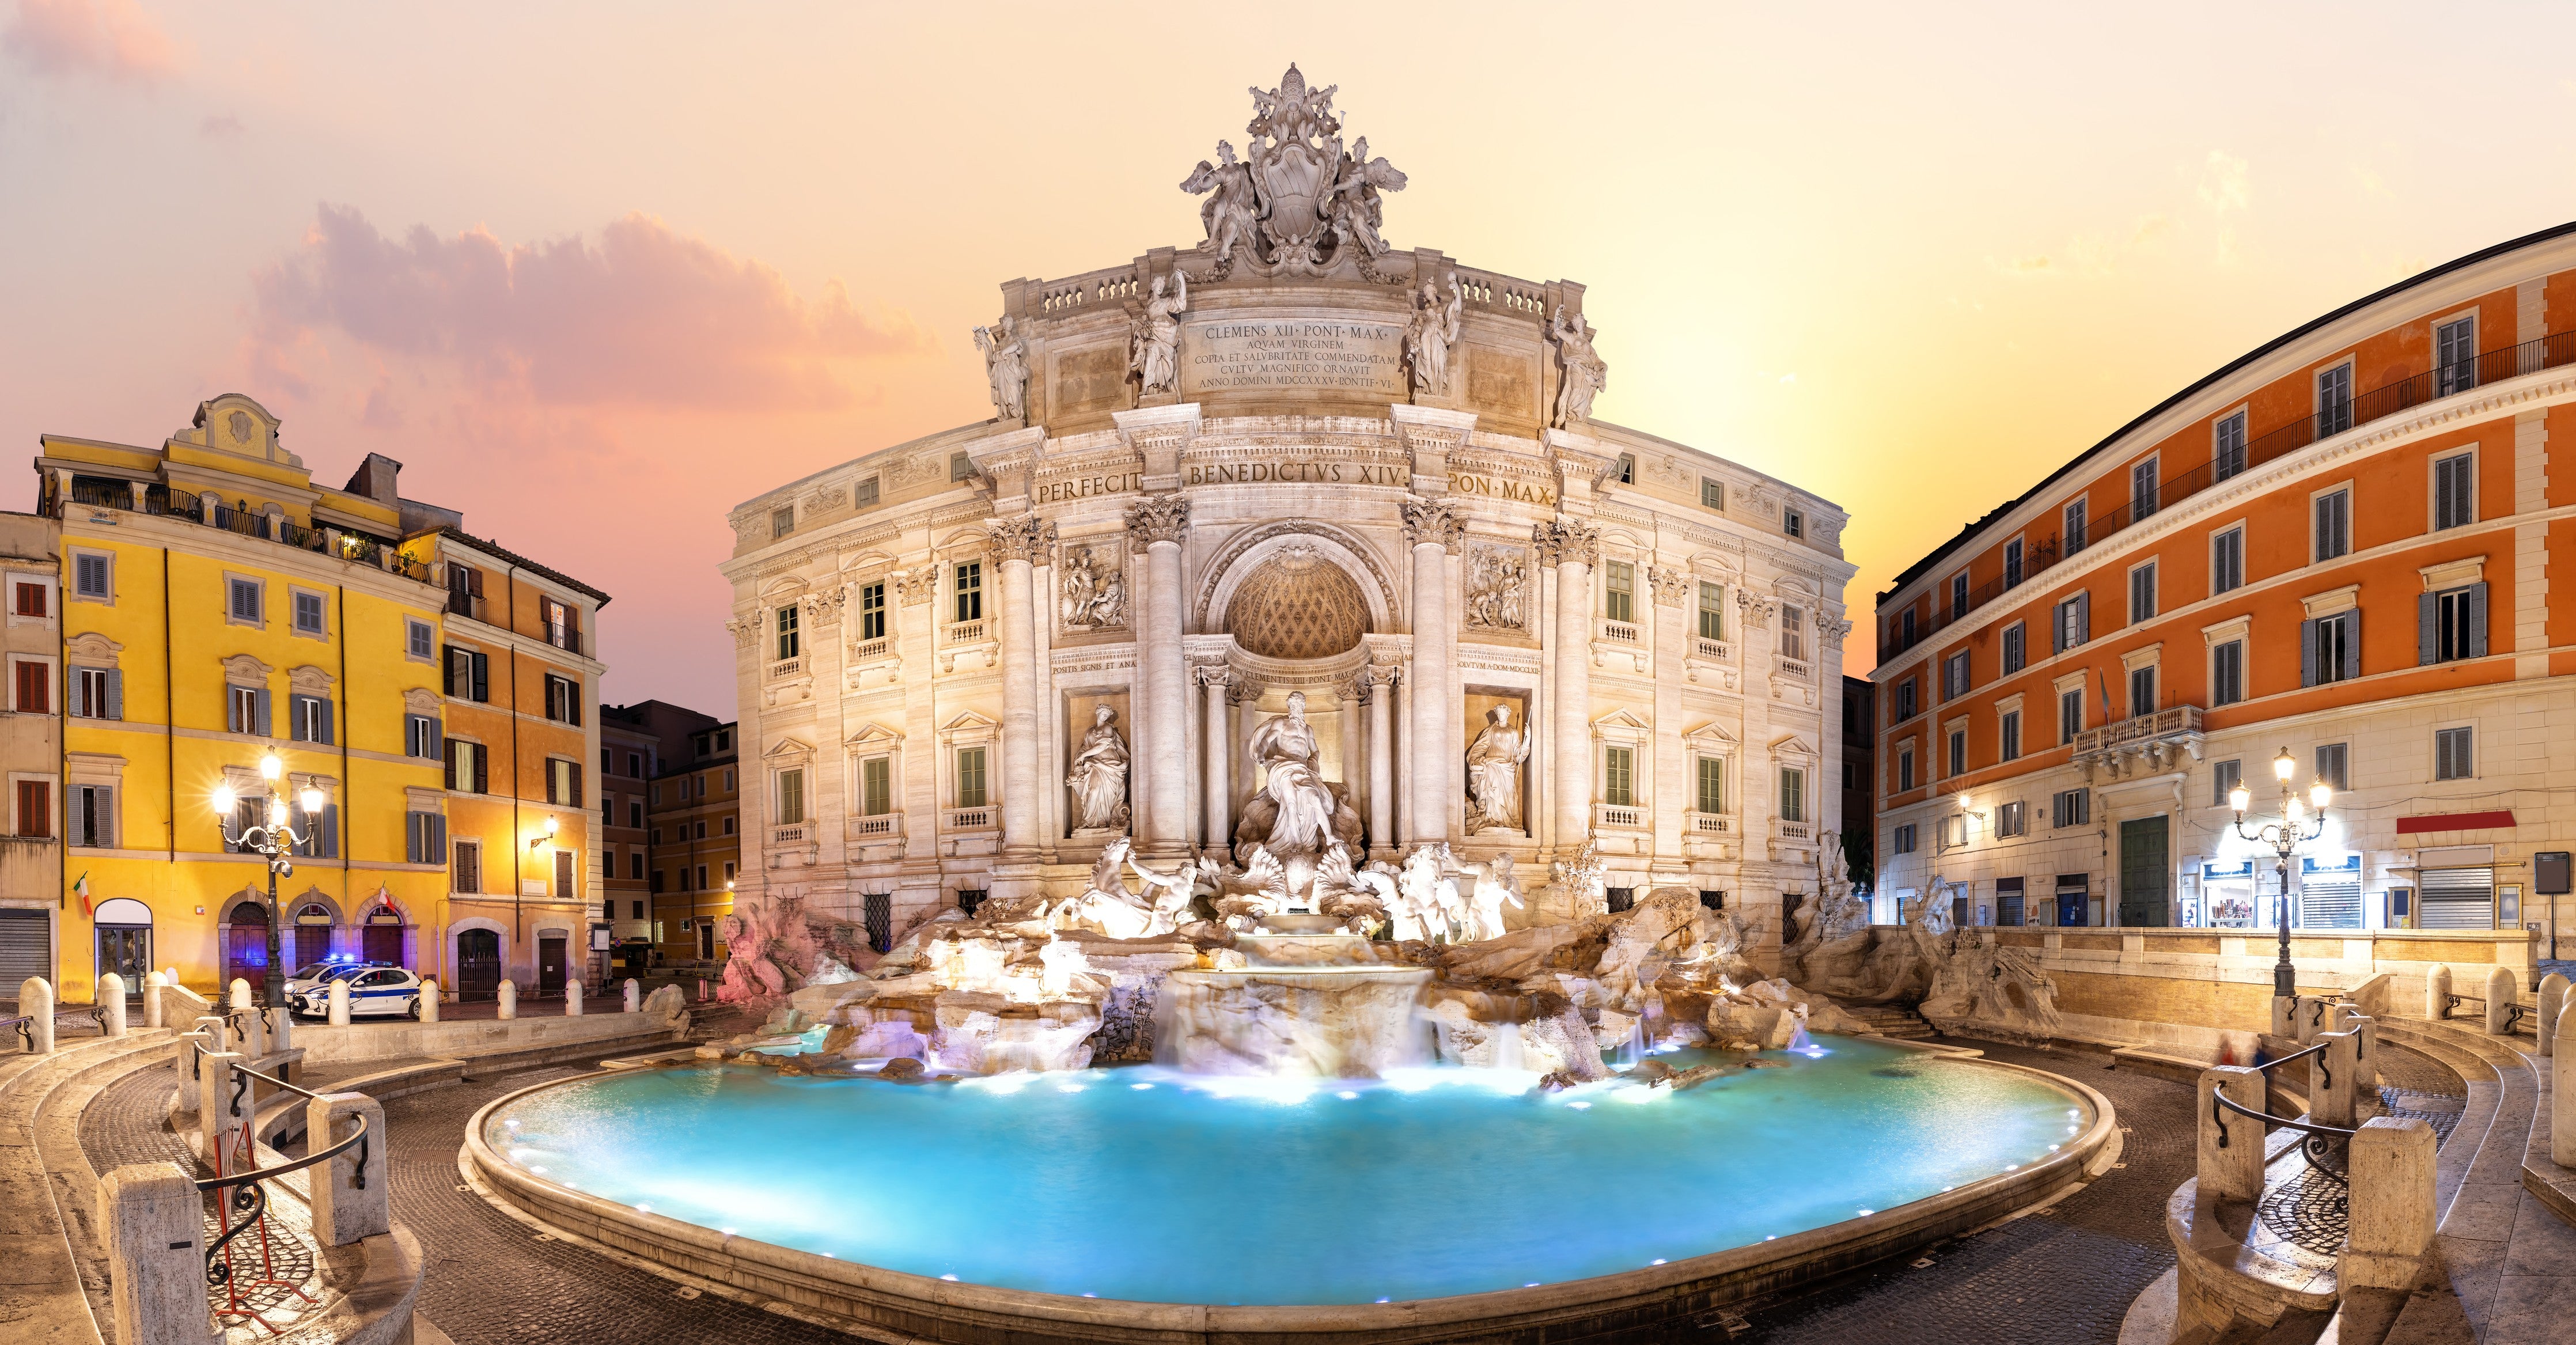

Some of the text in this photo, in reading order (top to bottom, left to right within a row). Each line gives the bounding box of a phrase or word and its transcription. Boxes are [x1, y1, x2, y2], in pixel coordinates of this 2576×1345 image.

[1206, 325, 1267, 339] CLEMENS
[1247, 340, 1344, 351] AQVAM VIRGINEM
[1195, 352, 1395, 365] COPIA ET SALVBRITATE COMMENDATAM
[1221, 364, 1371, 374] CVLTV MAGNIFICO ORNAVIT
[1199, 378, 1229, 388] ANNO
[1233, 376, 1271, 385] DOMINI
[1039, 472, 1142, 503] PERFECIT
[1189, 463, 1341, 484] BENEDICTVS
[1053, 665, 1077, 674] POSITIS
